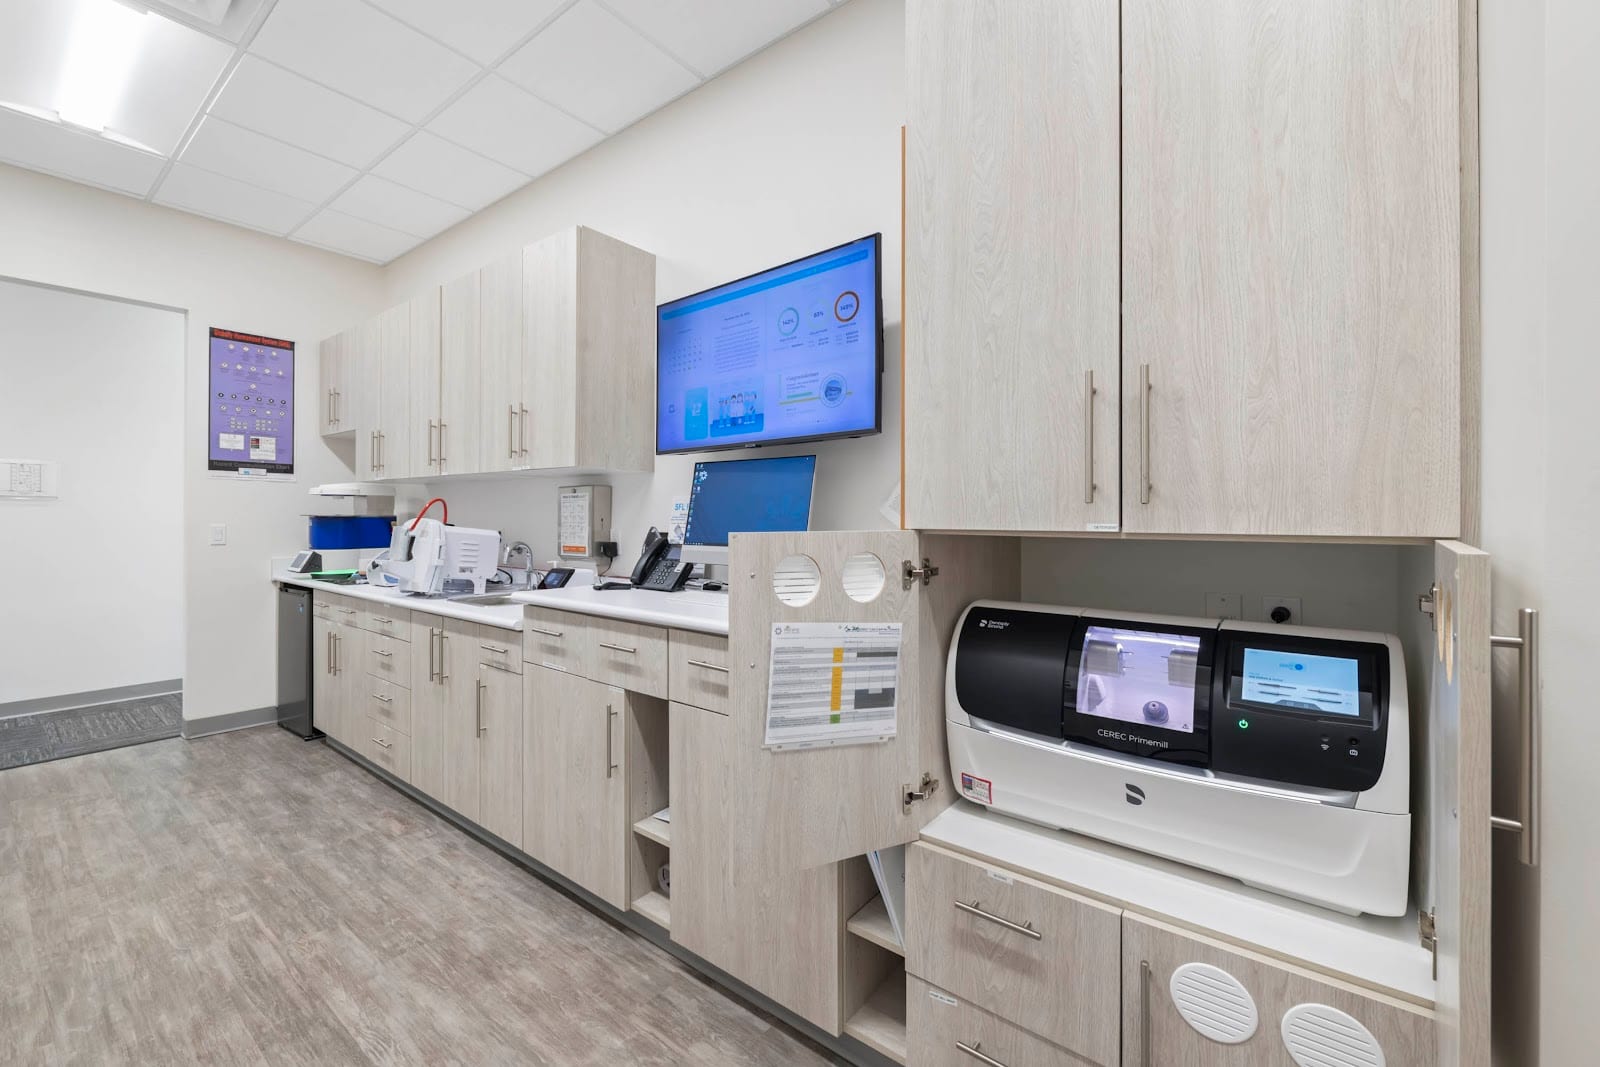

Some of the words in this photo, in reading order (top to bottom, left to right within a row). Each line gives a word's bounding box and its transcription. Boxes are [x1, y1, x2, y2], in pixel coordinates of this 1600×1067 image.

[674, 503, 685, 511] SFL
[1097, 728, 1127, 741] CEREC
[1128, 734, 1169, 749] Primemill
